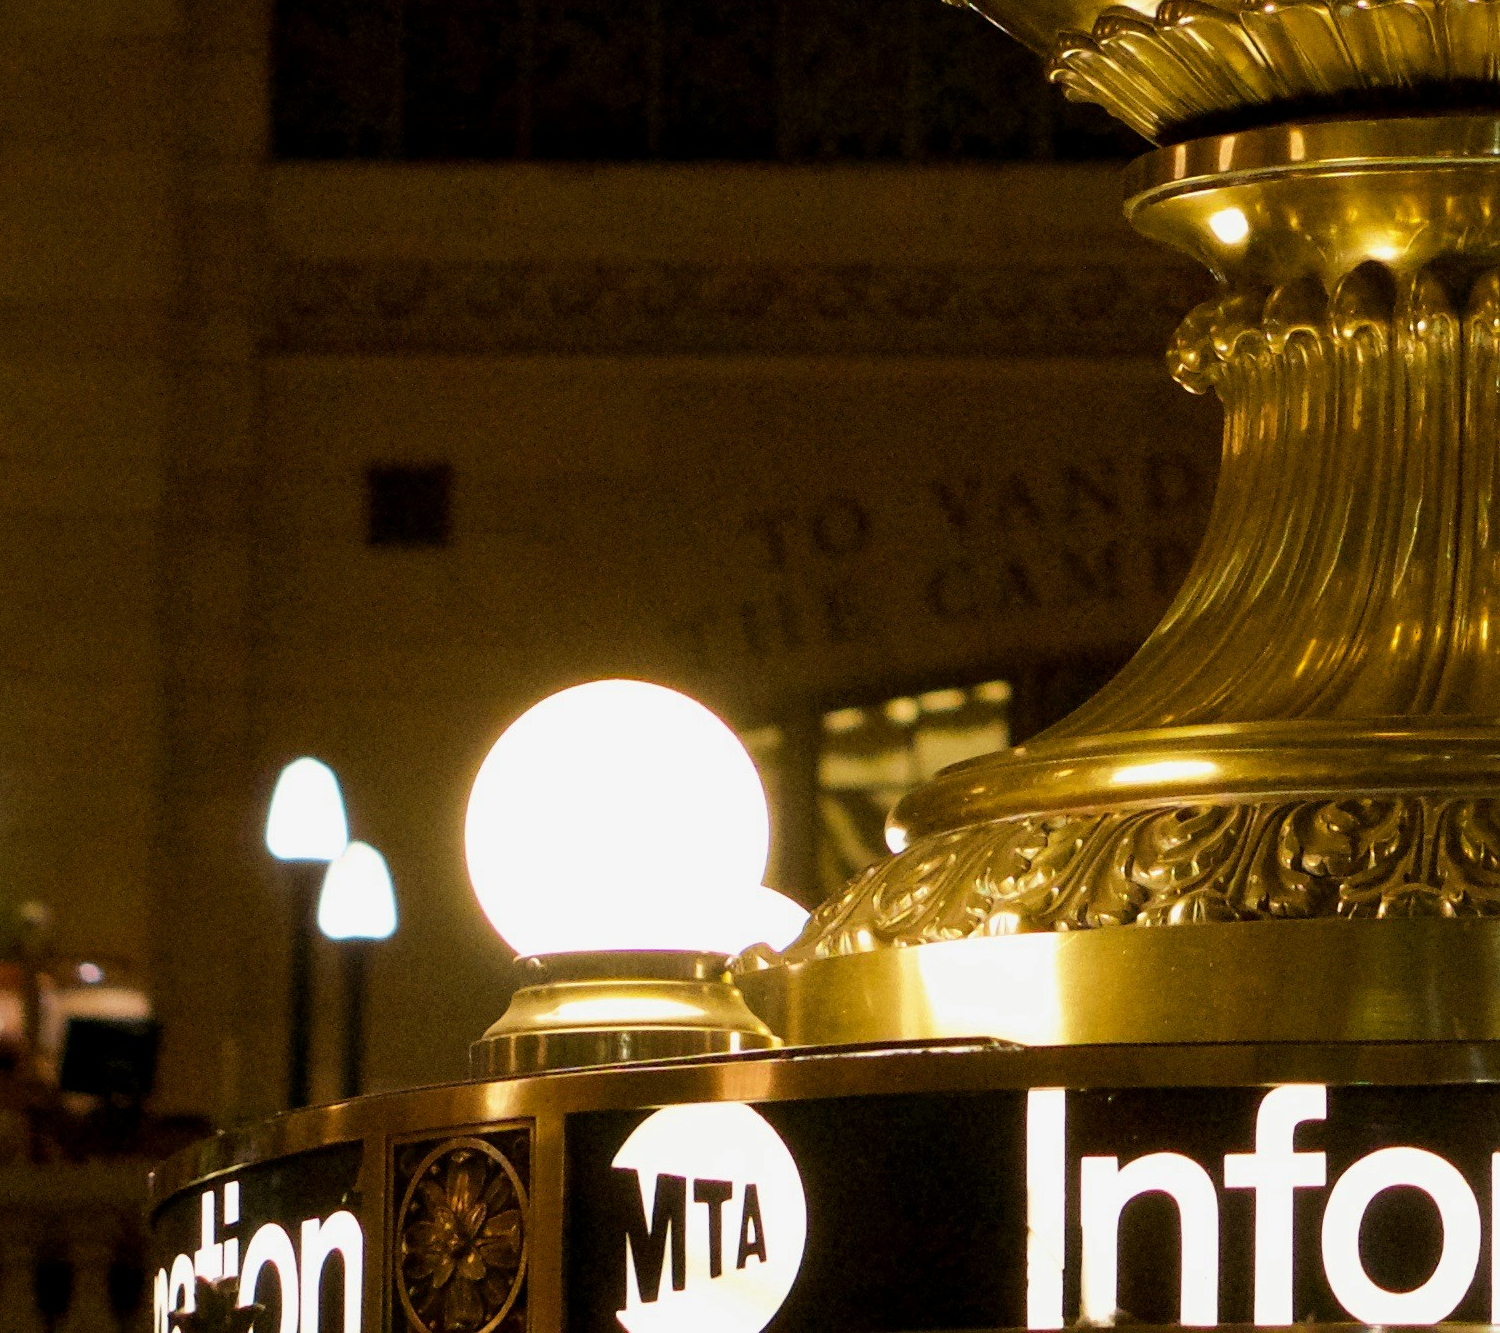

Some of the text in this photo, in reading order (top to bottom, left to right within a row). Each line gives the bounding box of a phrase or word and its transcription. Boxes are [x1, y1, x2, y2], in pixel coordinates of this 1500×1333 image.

[740, 493, 873, 570] TO
[930, 449, 1204, 532] VAND
[670, 583, 871, 663] THE
[612, 1167, 767, 1310] MTA
